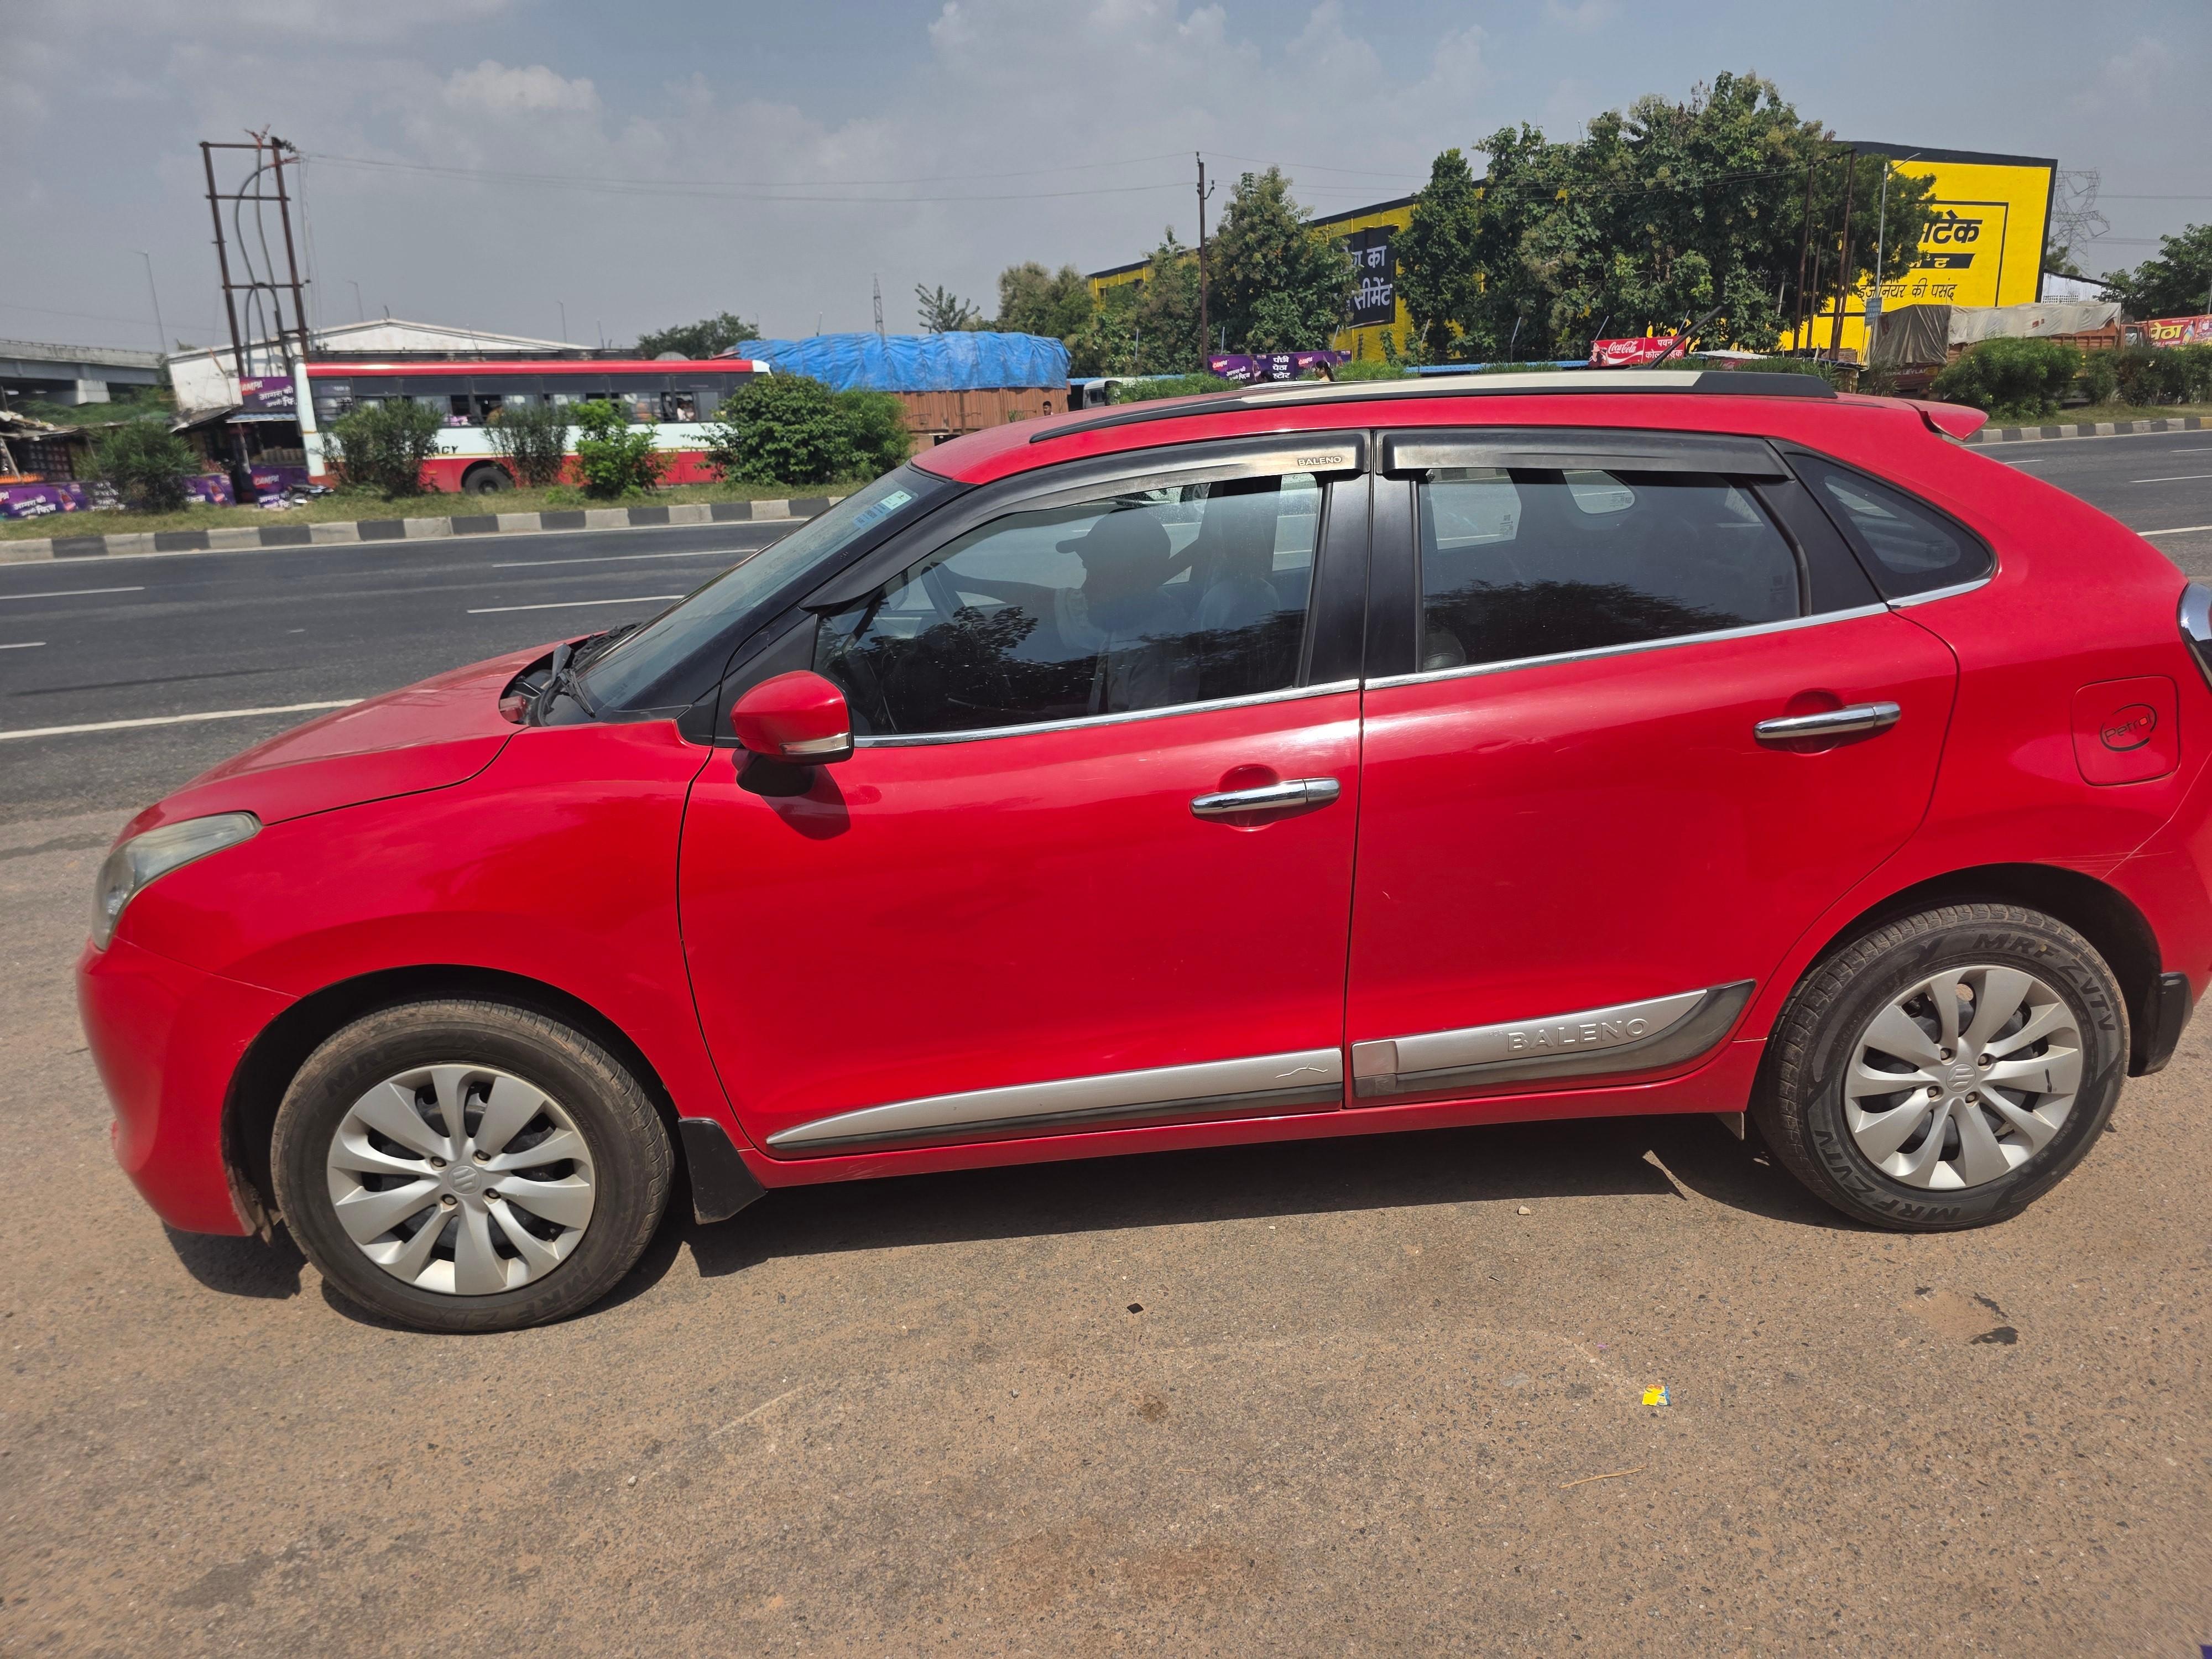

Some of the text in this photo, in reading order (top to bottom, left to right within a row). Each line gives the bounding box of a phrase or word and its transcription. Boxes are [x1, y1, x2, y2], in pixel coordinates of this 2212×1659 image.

[1366, 246, 1387, 268] का
[1354, 277, 1391, 310] सीमेंट
[1912, 278, 1928, 298] की
[1932, 278, 1958, 301] पसंद
[1657, 338, 1673, 347] पवन
[2150, 322, 2184, 340] पेठा
[242, 379, 263, 392] AMPA
[1297, 456, 1342, 466] BALENO
[2104, 713, 2151, 742] Petrol
[1972, 933, 2060, 958] MRF
[1507, 1018, 1649, 1052] BALENO
[1871, 1199, 1961, 1222] MRF
